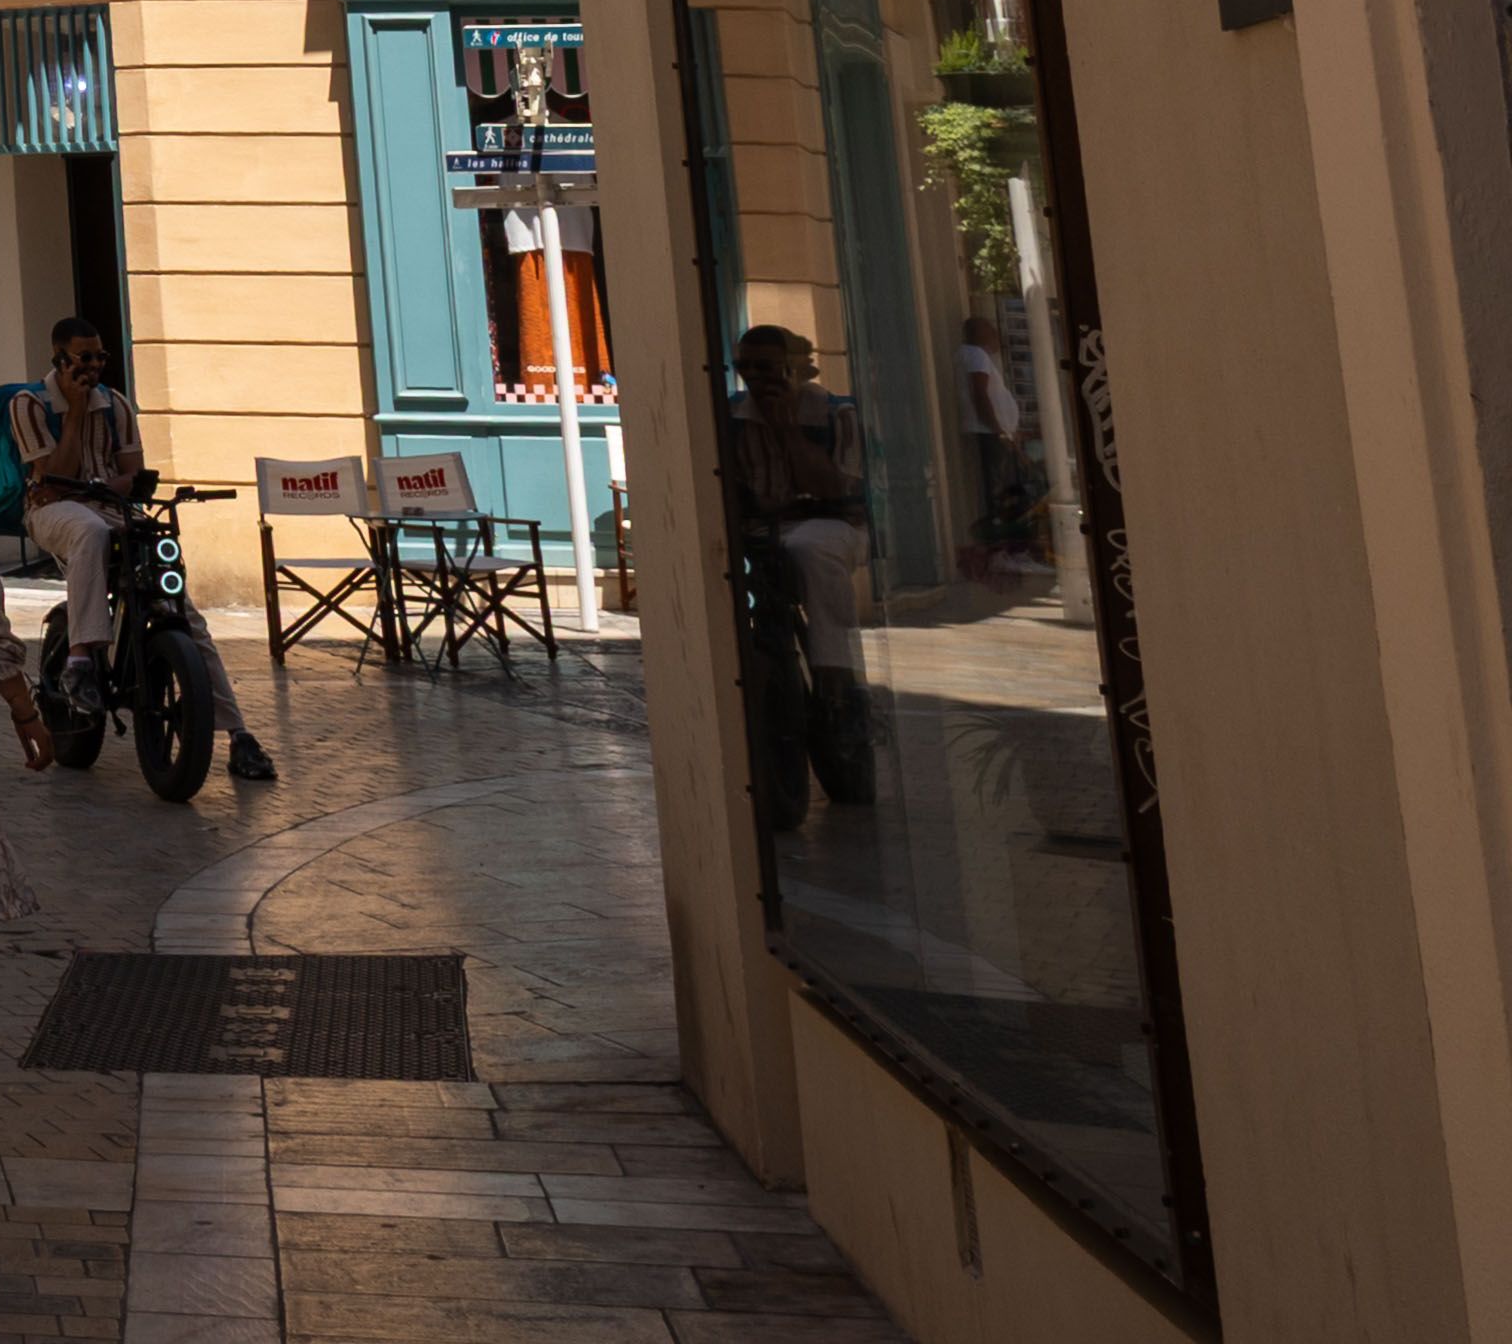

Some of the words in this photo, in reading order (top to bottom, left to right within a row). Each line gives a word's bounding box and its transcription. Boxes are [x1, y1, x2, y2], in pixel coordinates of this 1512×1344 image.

[506, 31, 540, 43] office
[544, 31, 558, 42] de
[467, 158, 485, 168] les
[281, 471, 338, 492] natif
[396, 467, 447, 490] natif
